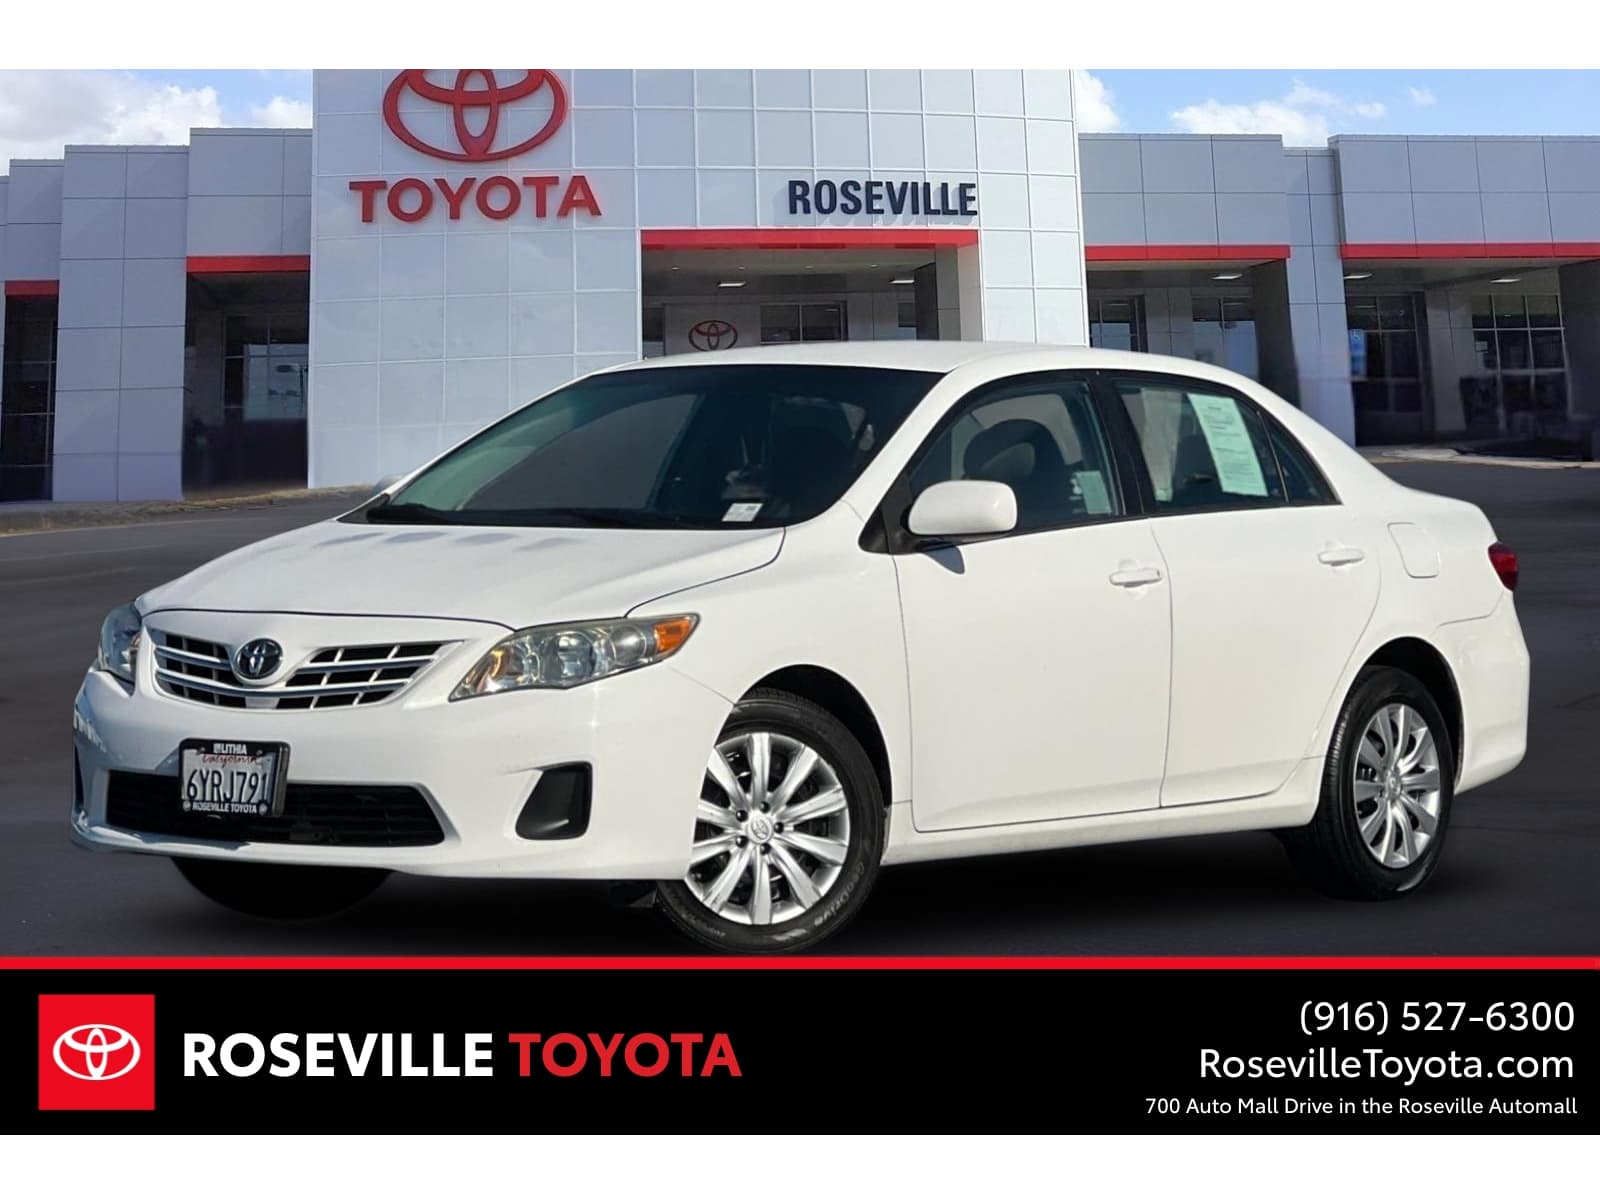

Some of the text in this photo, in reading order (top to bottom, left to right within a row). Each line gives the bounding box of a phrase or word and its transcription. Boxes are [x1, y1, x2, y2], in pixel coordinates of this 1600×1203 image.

[349, 175, 602, 223] TOYOTA
[788, 179, 978, 216] ROSEVILLE
[221, 743, 248, 755] LITHIA
[186, 768, 269, 804] 6YRJ791
[192, 801, 258, 814] ROSEVILLE TOYOTA
